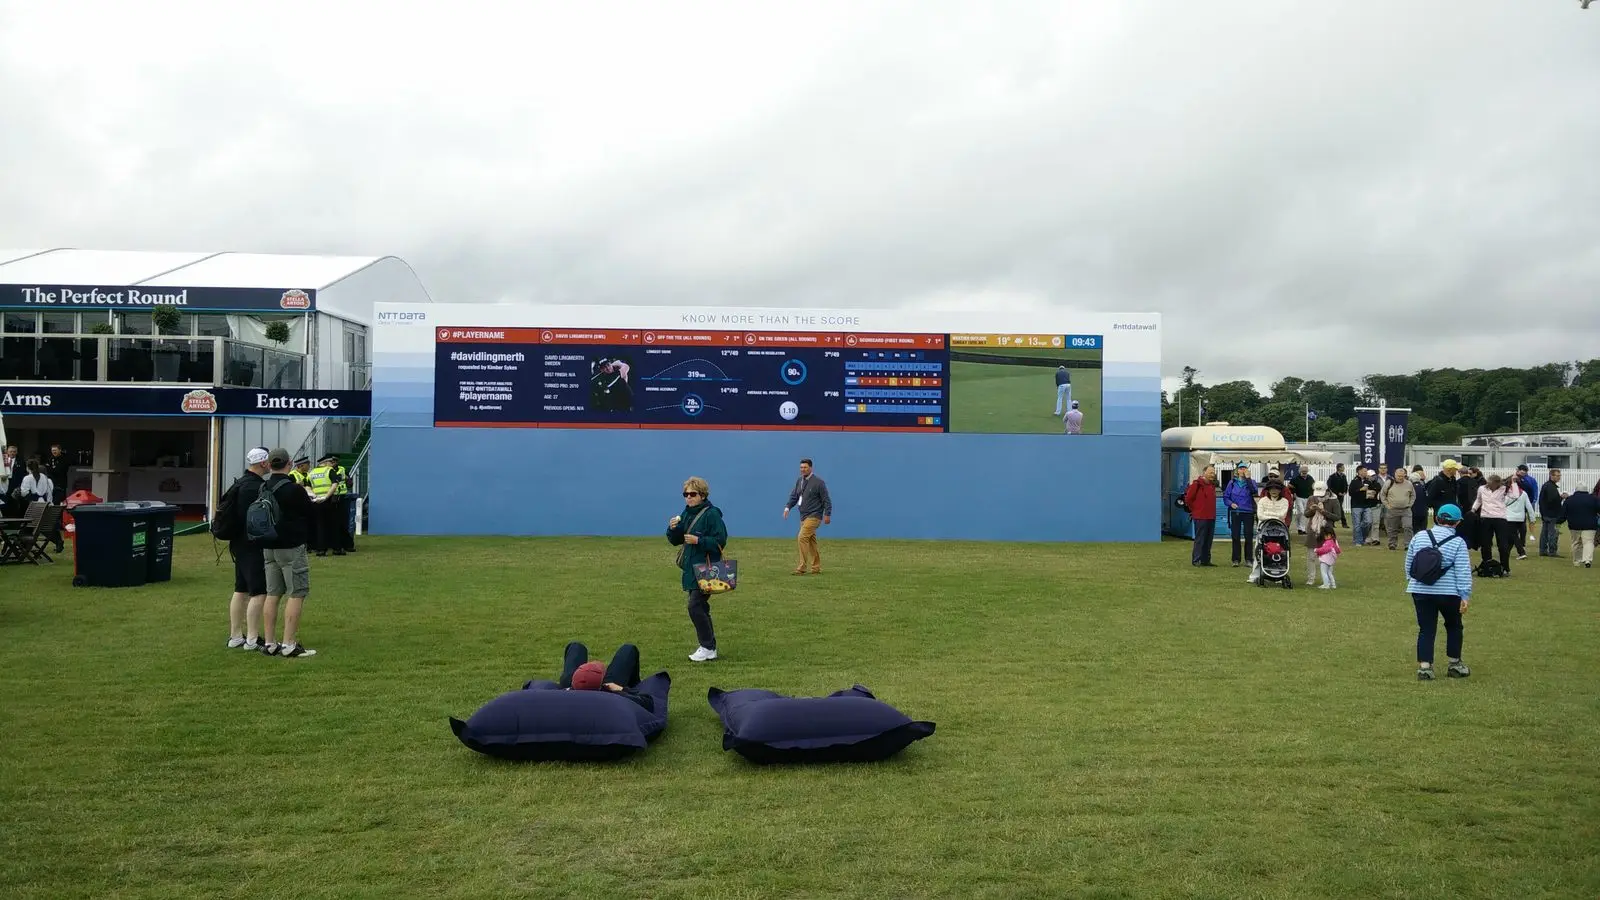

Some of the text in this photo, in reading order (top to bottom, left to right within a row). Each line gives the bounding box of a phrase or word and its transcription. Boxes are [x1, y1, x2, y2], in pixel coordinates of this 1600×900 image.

[22, 287, 187, 305] The Perfect Round
[682, 315, 860, 325] KNOW MORE THAN THE SCORE
[997, 336, 1011, 345] 19°
[1072, 338, 1095, 346] 09:43
[451, 352, 524, 363] #davidlingmerth
[1, 391, 51, 406] Arms
[256, 393, 339, 409] Entrance
[460, 392, 512, 401] #playername
[1213, 433, 1264, 442] Ice Cream
[1365, 424, 1375, 464] Toilets
